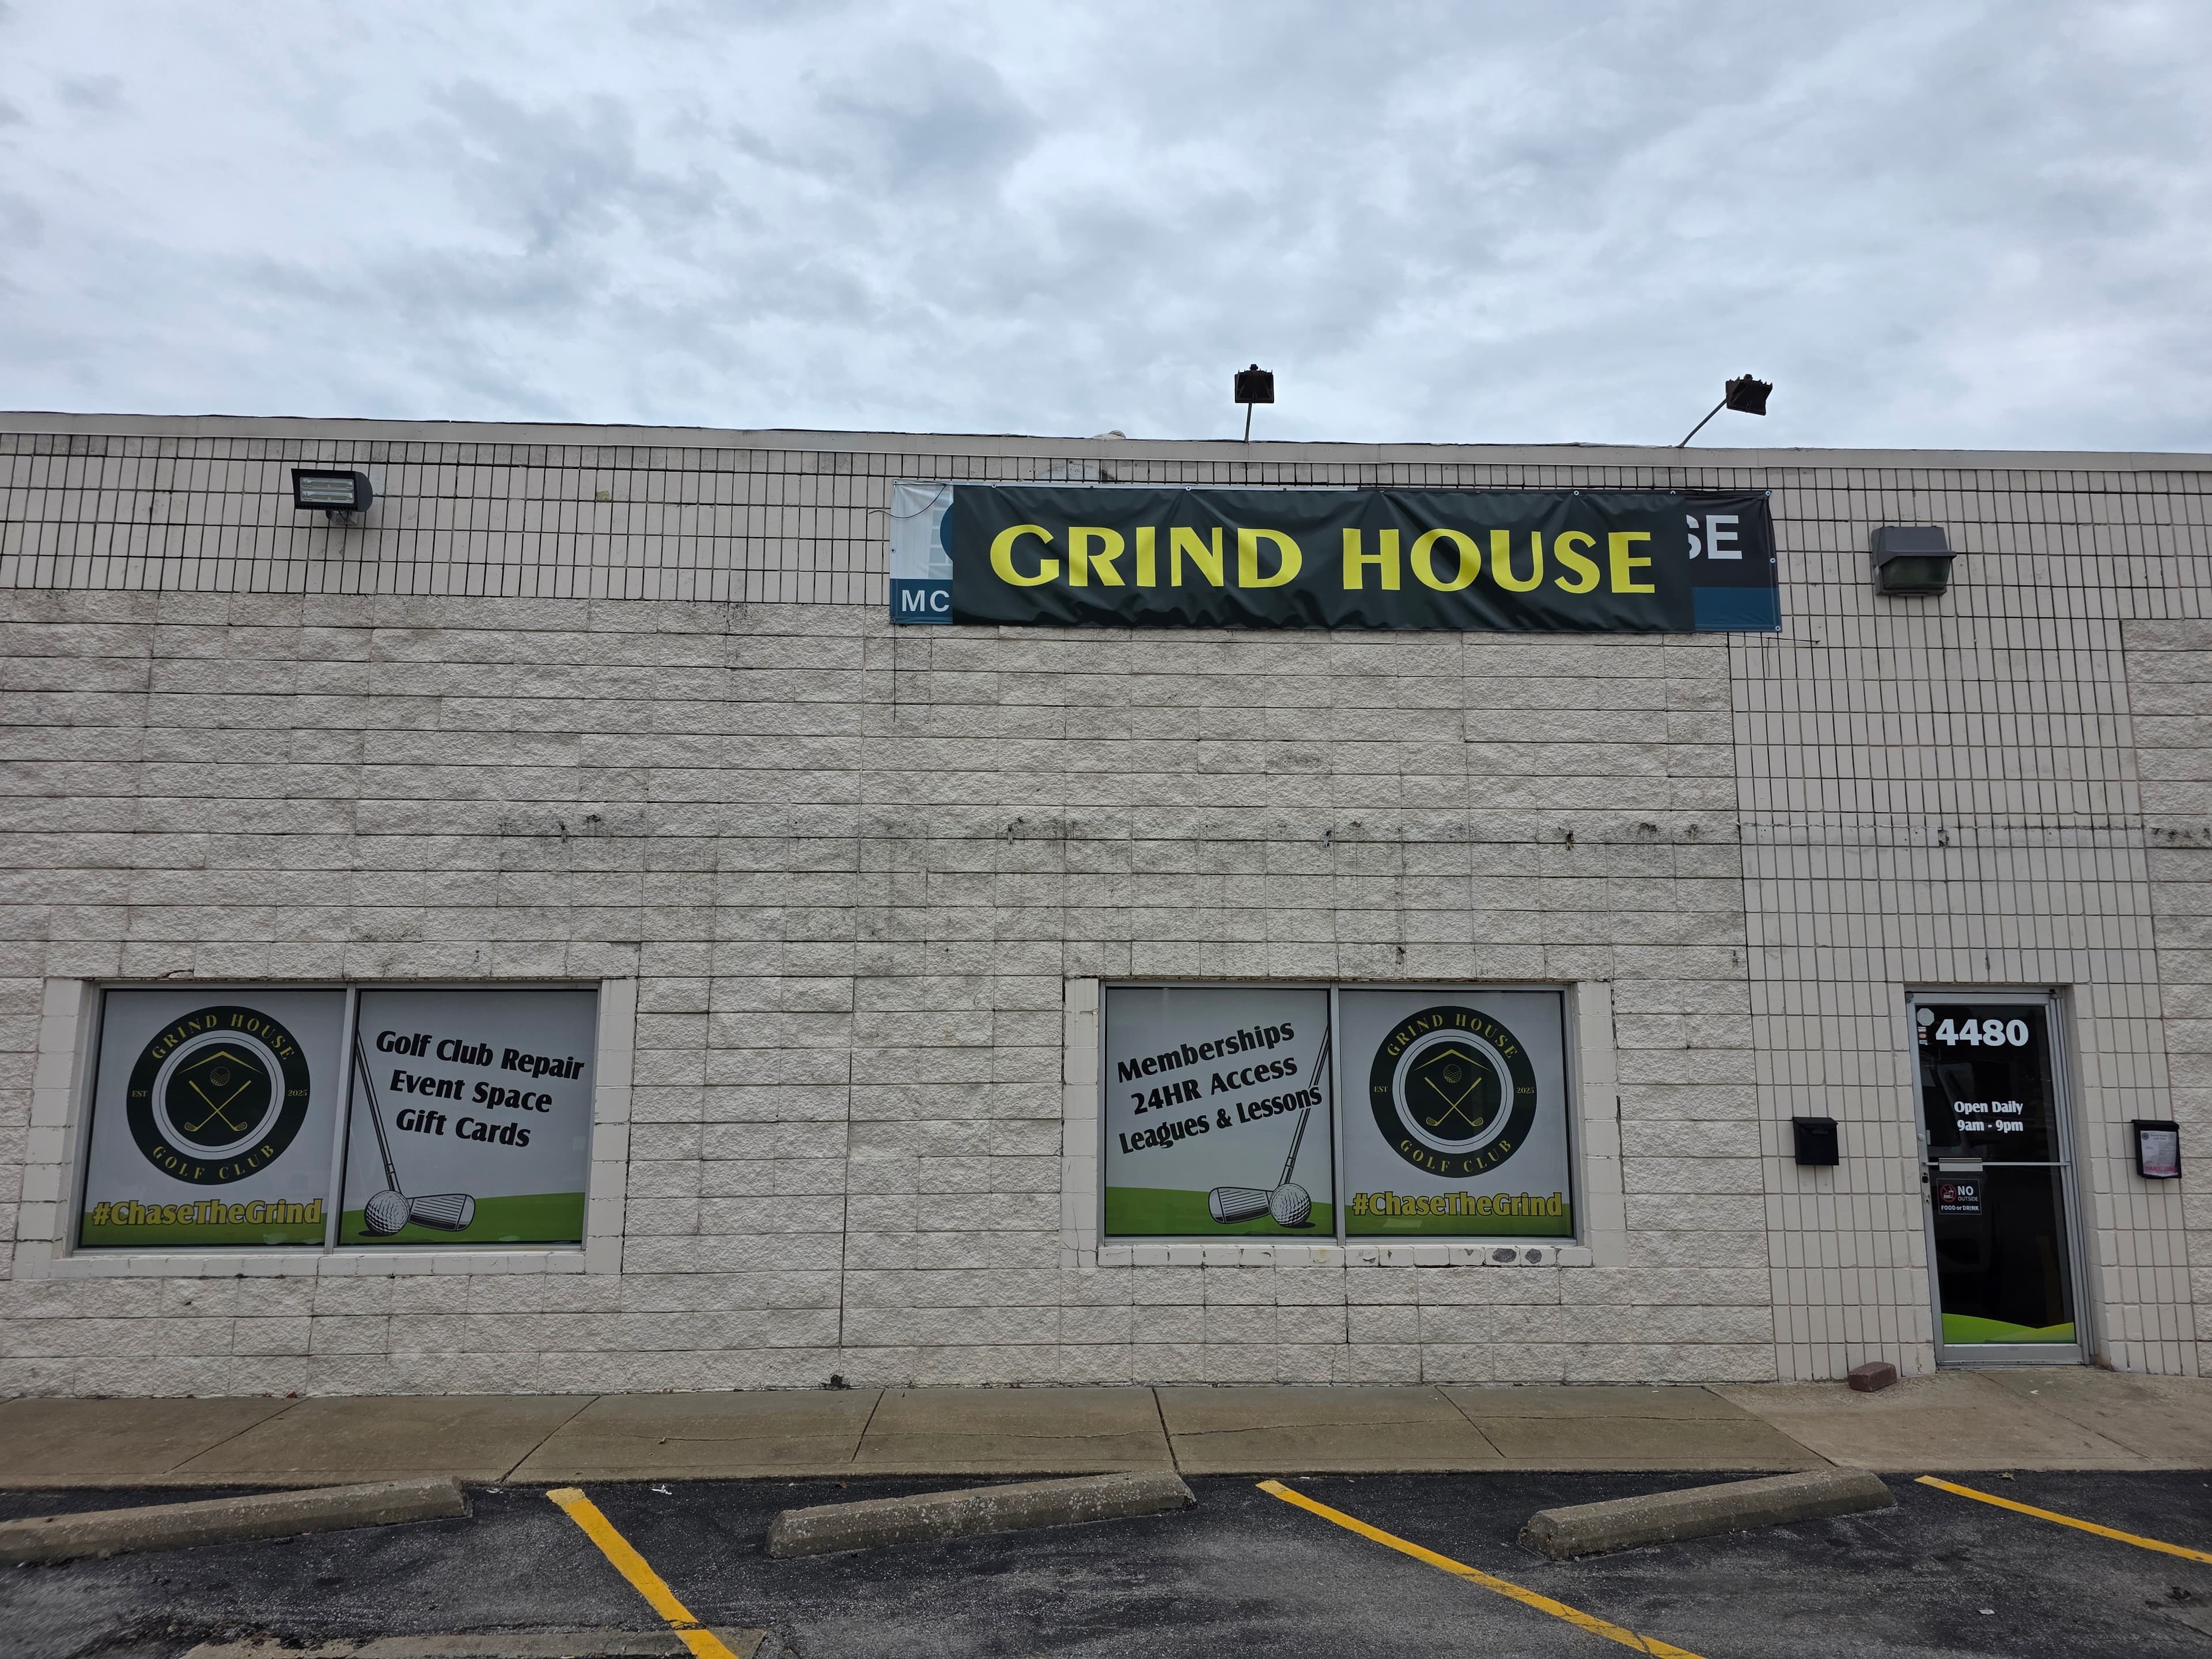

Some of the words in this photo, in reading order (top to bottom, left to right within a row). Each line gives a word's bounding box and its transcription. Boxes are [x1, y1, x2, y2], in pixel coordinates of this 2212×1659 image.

[990, 524, 1302, 588] GRIND
[1342, 528, 1655, 594] HOUSE
[902, 589, 950, 612] MC
[151, 1014, 217, 1059] GRIND
[230, 1013, 296, 1060] HOUSE
[1387, 1014, 1443, 1056] GRIND
[1455, 1013, 1518, 1059] HOUSE
[1935, 1018, 2029, 1047] 4480
[376, 1030, 433, 1058] Golf
[436, 1039, 494, 1067] Club
[500, 1047, 585, 1080] Repair
[1117, 1022, 1295, 1084] Memberships
[287, 1089, 308, 1097] 2025
[389, 1069, 465, 1100] Event
[471, 1081, 553, 1113] Space
[1130, 1078, 1203, 1115] 24HR
[1210, 1057, 1298, 1096] Access
[1119, 1115, 1210, 1154] Leagues
[1216, 1108, 1233, 1129] &
[1236, 1086, 1323, 1124] Lessons
[1954, 1101, 1988, 1115] Open
[1991, 1100, 2024, 1115] Daily
[396, 1108, 447, 1136] Gift
[455, 1116, 531, 1147] Cards
[1957, 1119, 1984, 1131] 9am
[1995, 1119, 2024, 1133] 9pm
[152, 1146, 205, 1179] GOLF
[218, 1145, 274, 1180] CLUB
[1400, 1139, 1451, 1172] GOLF
[1463, 1139, 1511, 1173] CLUB
[1353, 1191, 1563, 1217] #ChaseTheGrind
[1957, 1185, 1974, 1196] NO
[93, 1198, 323, 1226] #ChaseTheGrind
